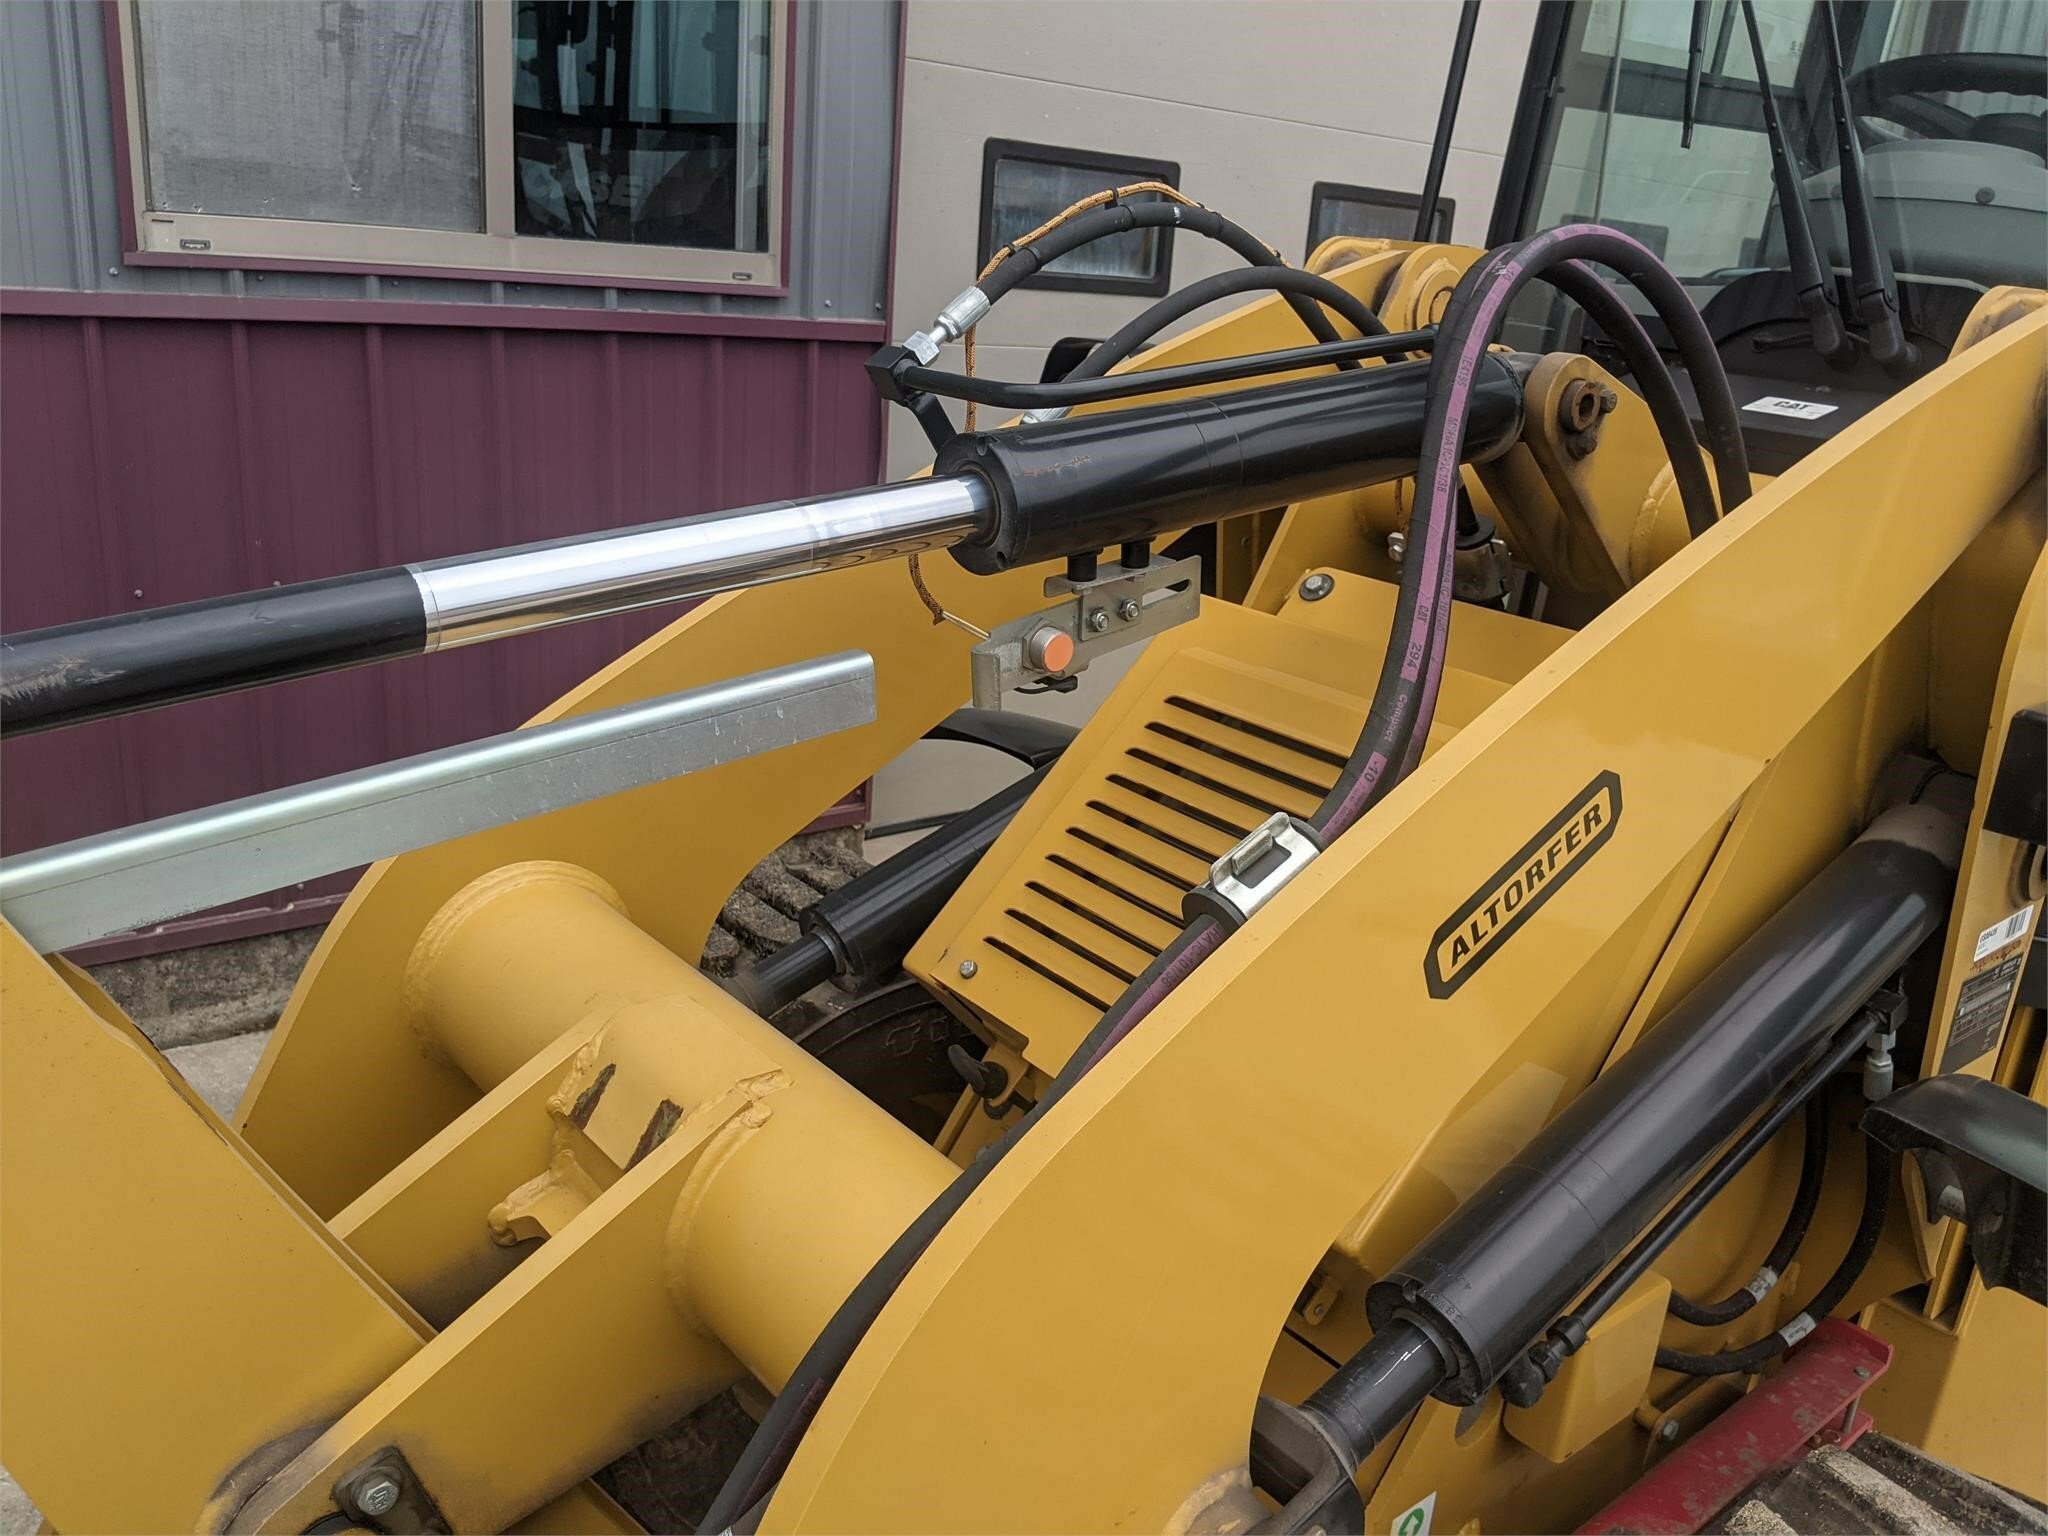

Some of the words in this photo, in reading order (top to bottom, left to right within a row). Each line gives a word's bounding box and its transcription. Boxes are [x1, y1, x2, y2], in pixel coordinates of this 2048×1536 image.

[1772, 401, 1811, 411] CAT
[1407, 642, 1423, 669] 294
[1384, 694, 1408, 742] Compact
[1451, 802, 1603, 969] ALTORFER
